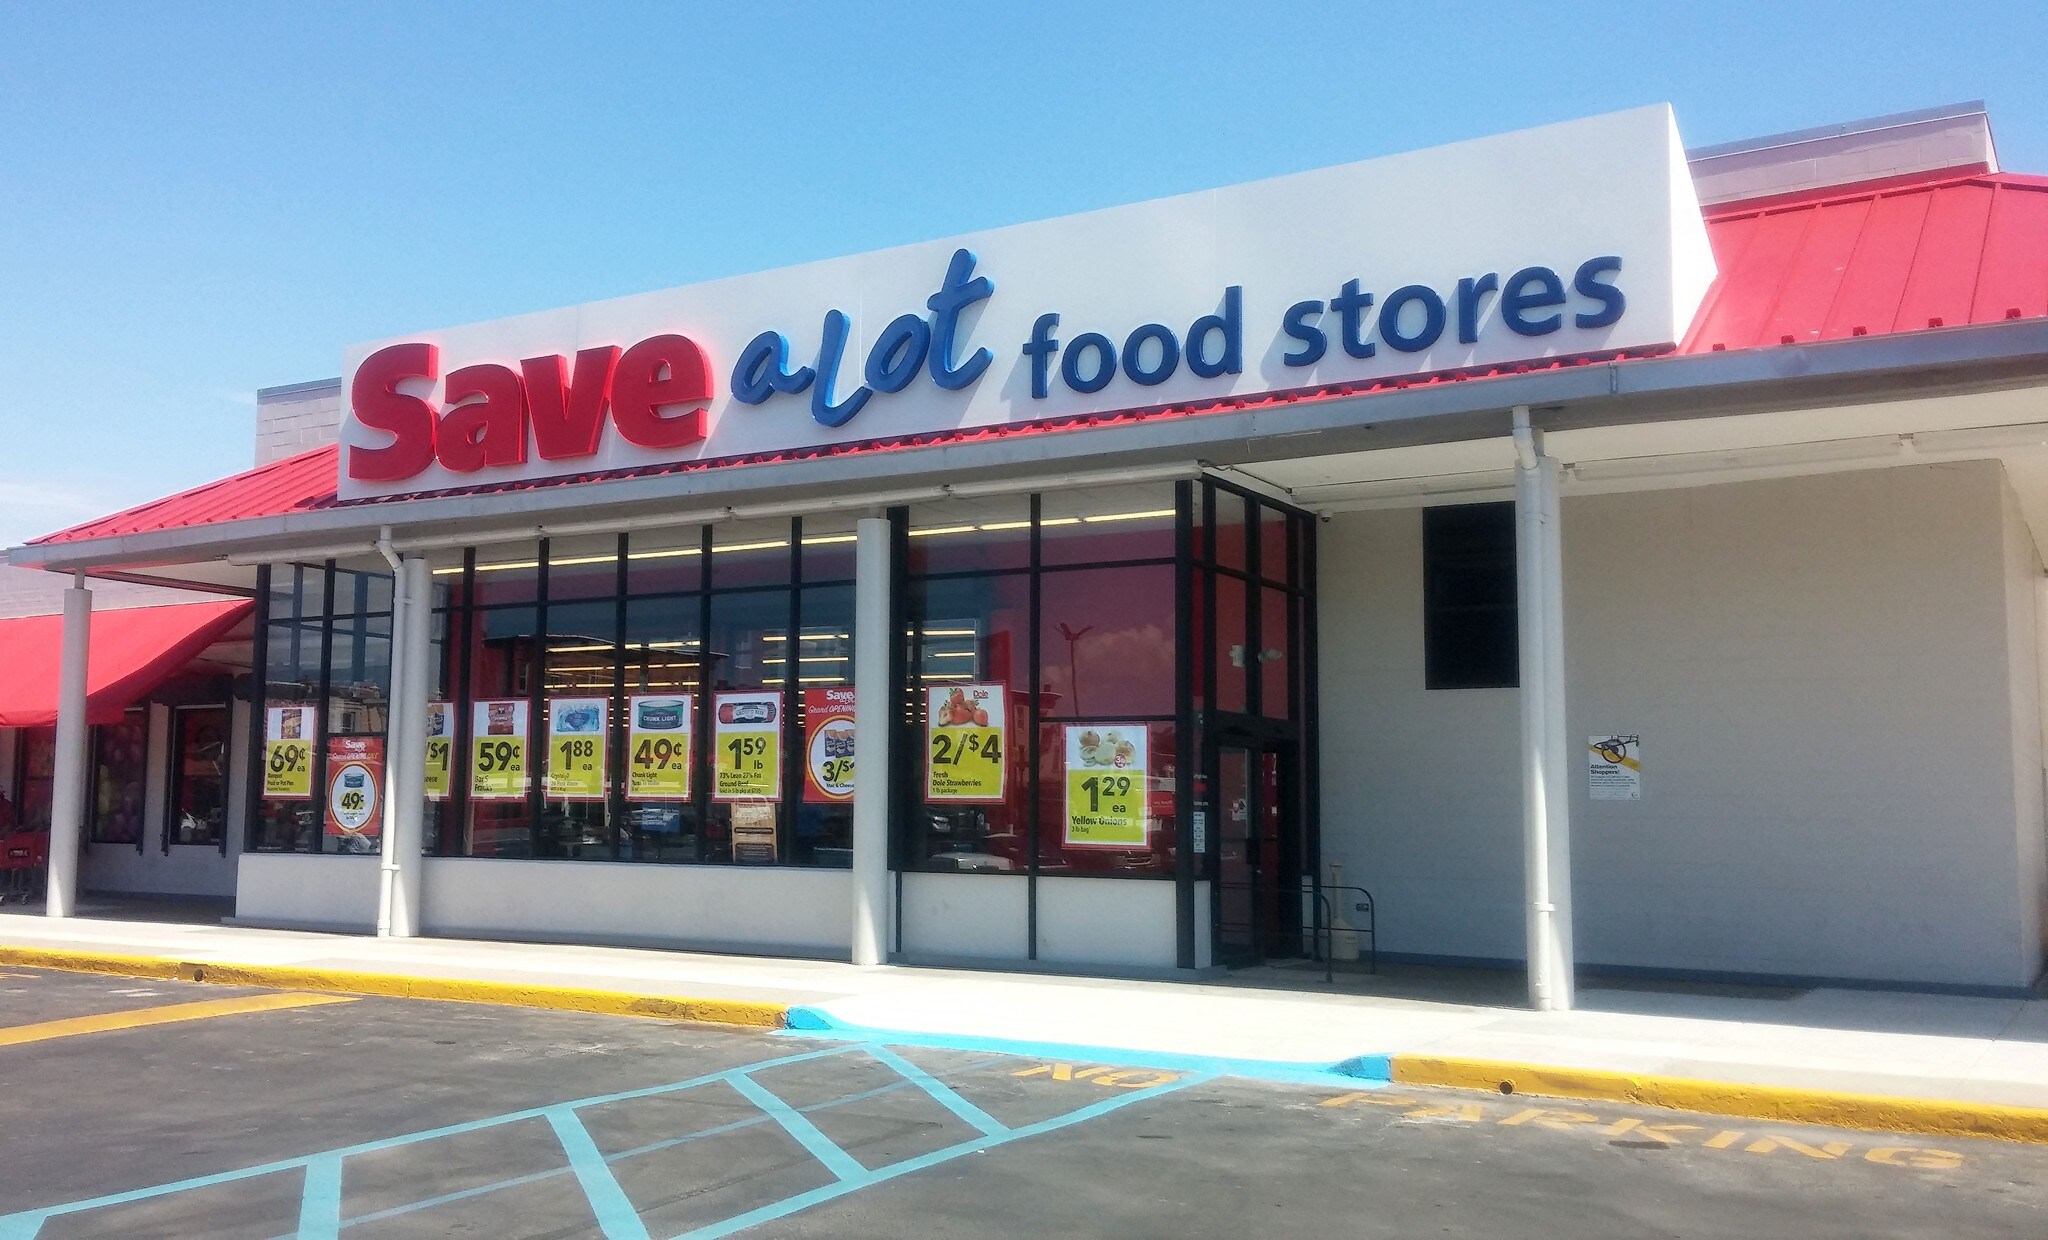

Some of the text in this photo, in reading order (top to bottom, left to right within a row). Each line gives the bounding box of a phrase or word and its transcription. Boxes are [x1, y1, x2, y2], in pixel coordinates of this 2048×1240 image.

[348, 333, 714, 481] Save
[731, 330, 816, 406] a
[1022, 285, 1243, 400] food
[1283, 255, 1627, 368] stores
[826, 690, 854, 700] Save
[754, 760, 763, 770] lb
[1112, 804, 1126, 812] ea
[1072, 816, 1127, 825] Yellow Onions
[1319, 1091, 1964, 1169] PARKING
